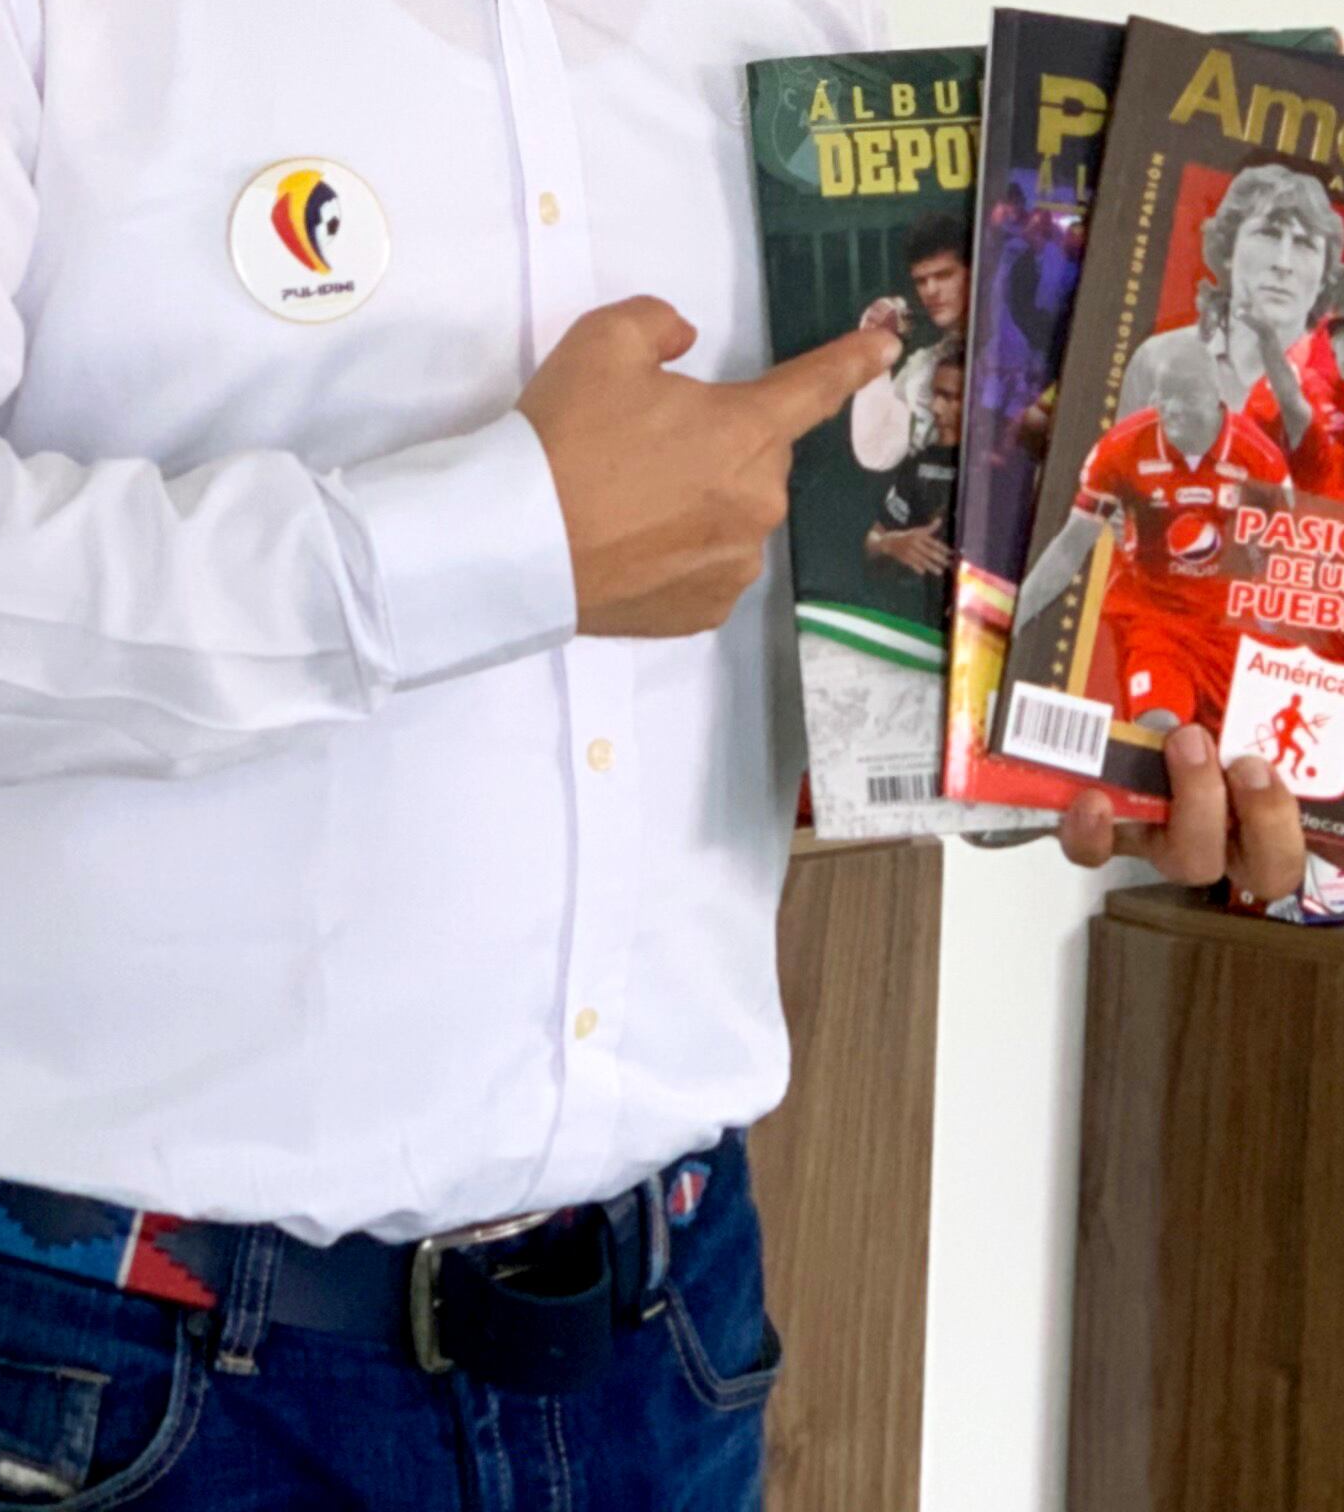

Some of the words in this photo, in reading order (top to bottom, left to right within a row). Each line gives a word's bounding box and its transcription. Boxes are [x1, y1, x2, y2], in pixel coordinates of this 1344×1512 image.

[809, 79, 961, 122] ÁLBU
[813, 125, 974, 198] DEPO
[1137, 151, 1166, 229] PASIÓN
[1130, 234, 1149, 275] UNA
[1123, 278, 1141, 307] DE
[1266, 554, 1317, 587] DE
